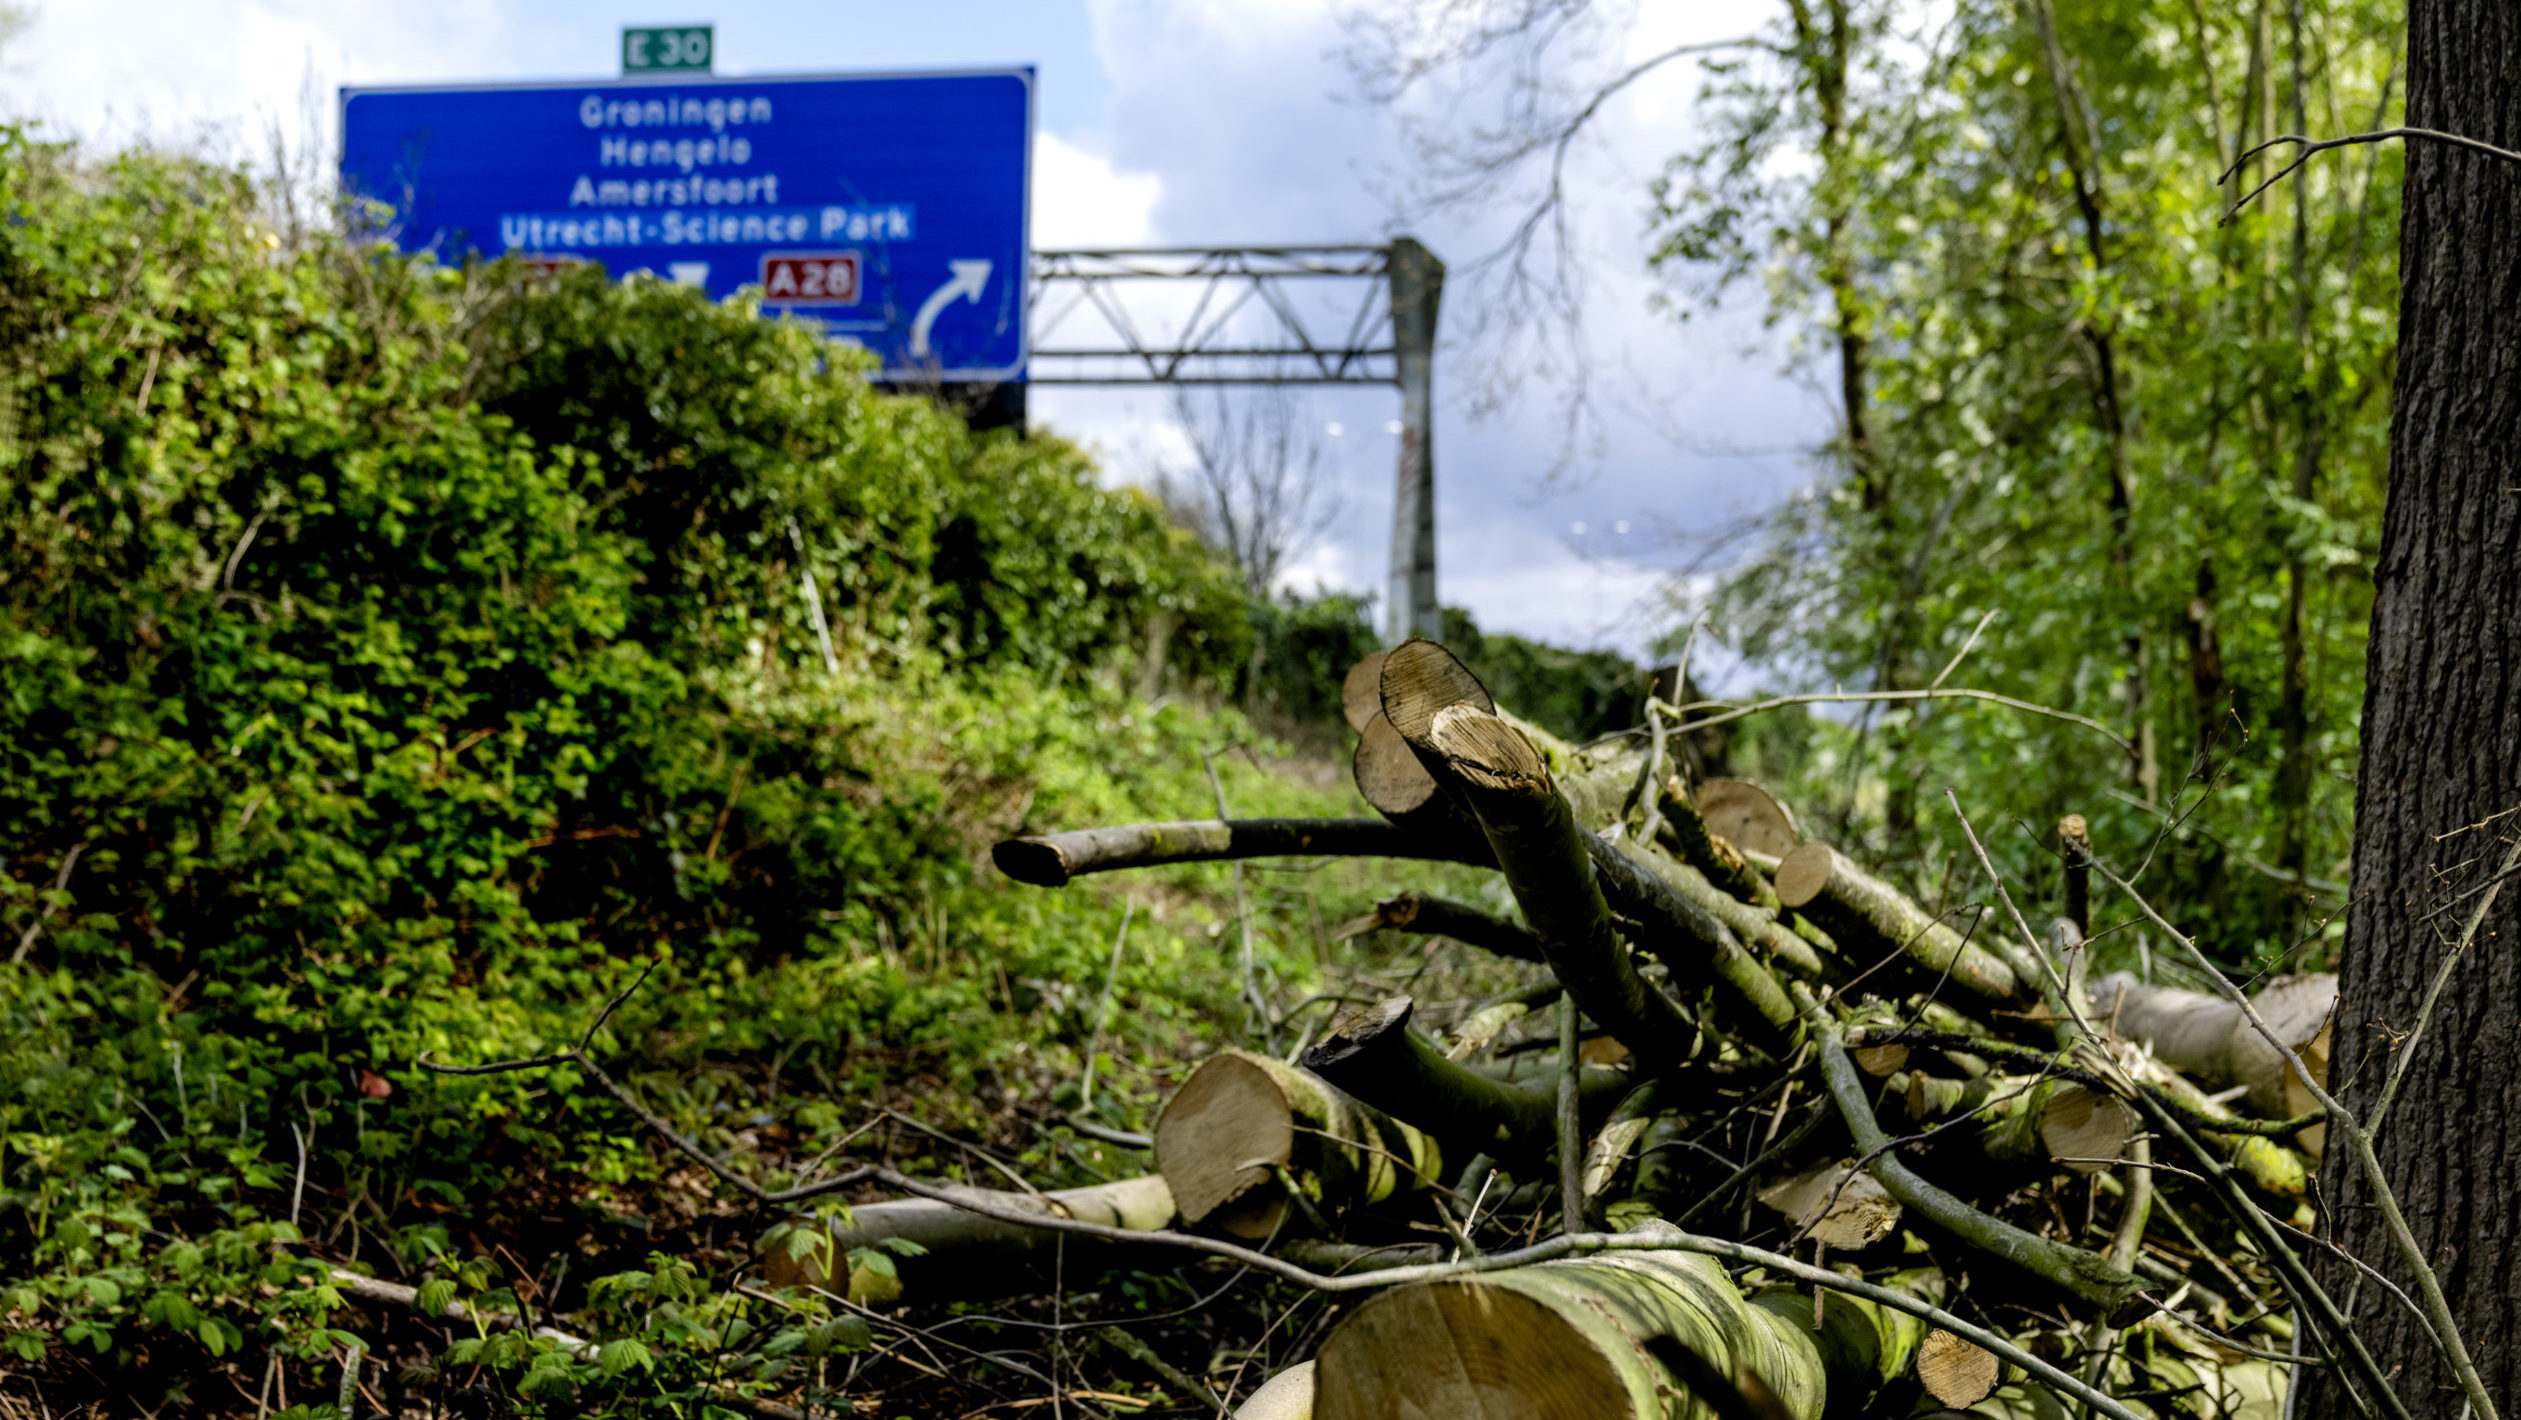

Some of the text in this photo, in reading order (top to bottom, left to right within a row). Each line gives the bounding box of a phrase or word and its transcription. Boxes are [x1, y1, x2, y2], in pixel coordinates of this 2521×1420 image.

[627, 32, 709, 66] E 30
[579, 95, 772, 132] Groningen
[600, 136, 752, 173] Hengelo
[570, 175, 779, 207] Amersfoort
[502, 206, 911, 246] Utrecht-Science Park
[768, 261, 853, 297] A28
